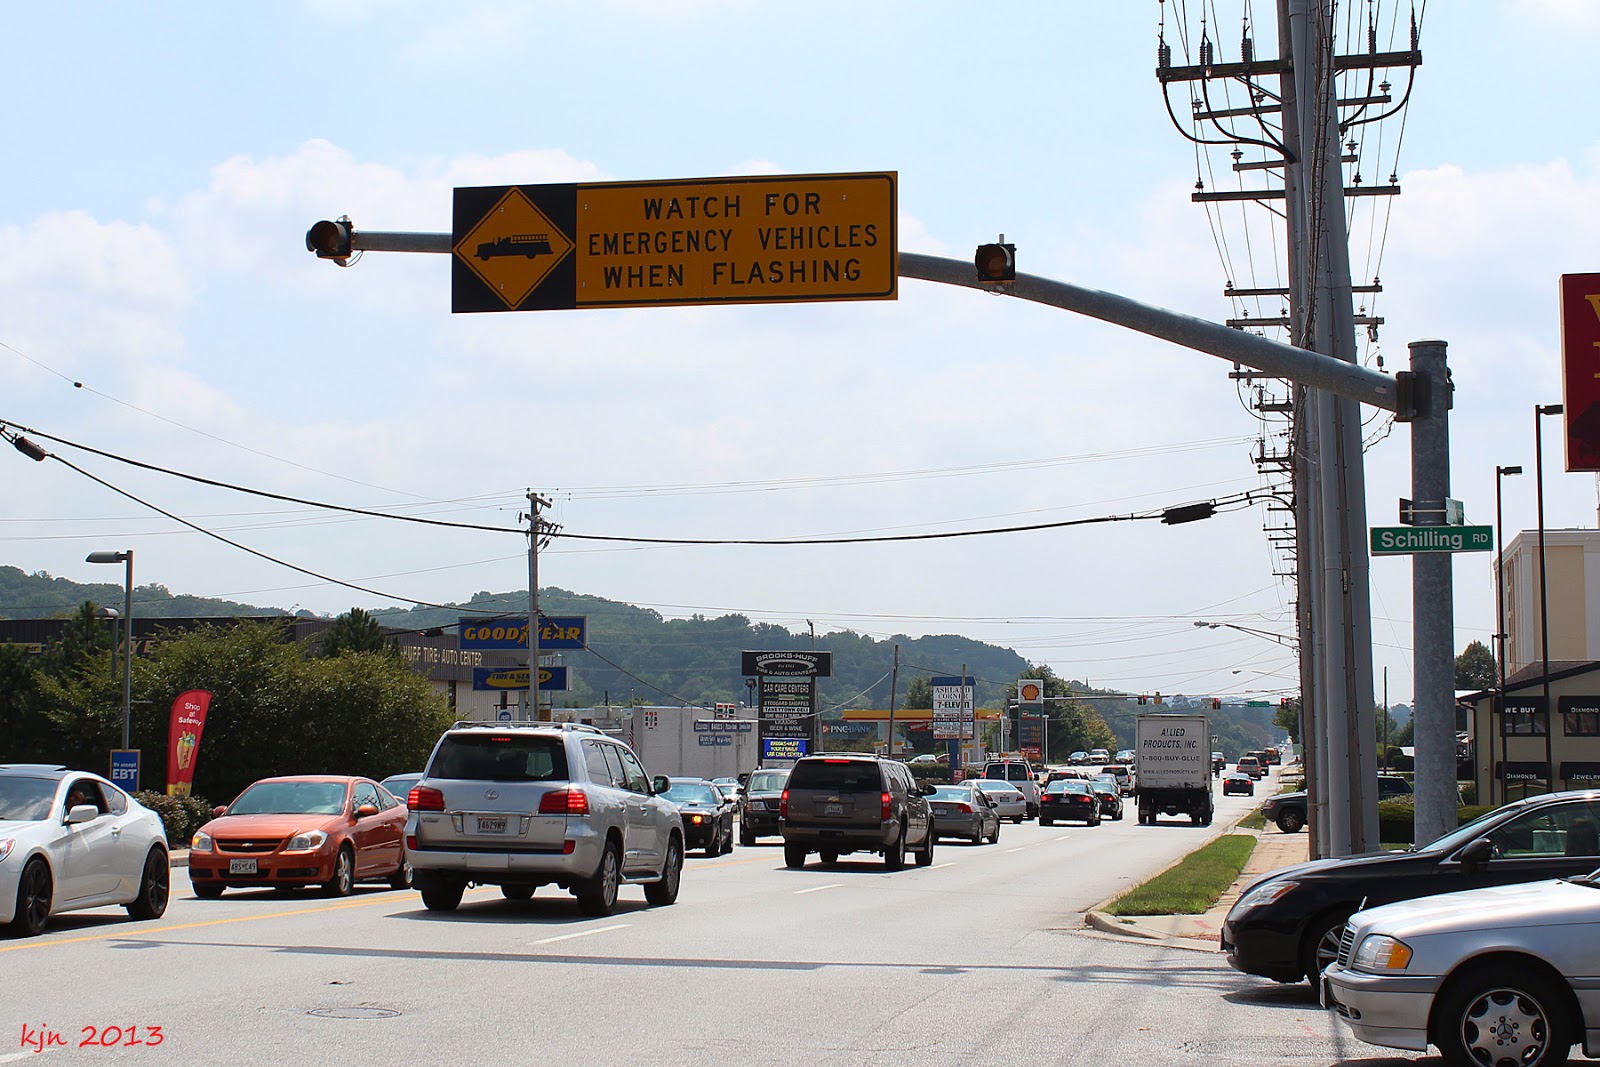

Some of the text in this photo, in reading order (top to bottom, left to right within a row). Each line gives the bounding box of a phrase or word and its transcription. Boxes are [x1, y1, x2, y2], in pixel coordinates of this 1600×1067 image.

[643, 192, 821, 221] WATCH FOR
[588, 223, 878, 257] EMERGENCY VEHICLES
[603, 258, 862, 289] WHEN FLASHING
[1380, 531, 1488, 549] Schilling RD
[464, 627, 581, 641] GOODEAR
[423, 647, 438, 663] TIRE
[441, 649, 458, 665] AUTO
[460, 651, 482, 666] CENTER
[756, 653, 818, 662] BROOKS-HUFF
[791, 668, 817, 676] CENTERS
[764, 684, 809, 693] CAR CARE CENTERS
[184, 702, 201, 711] Shop
[1161, 728, 1185, 736] ALLIED
[1143, 740, 1198, 749] PRODUCTS, INC.
[112, 768, 137, 780] EBT
